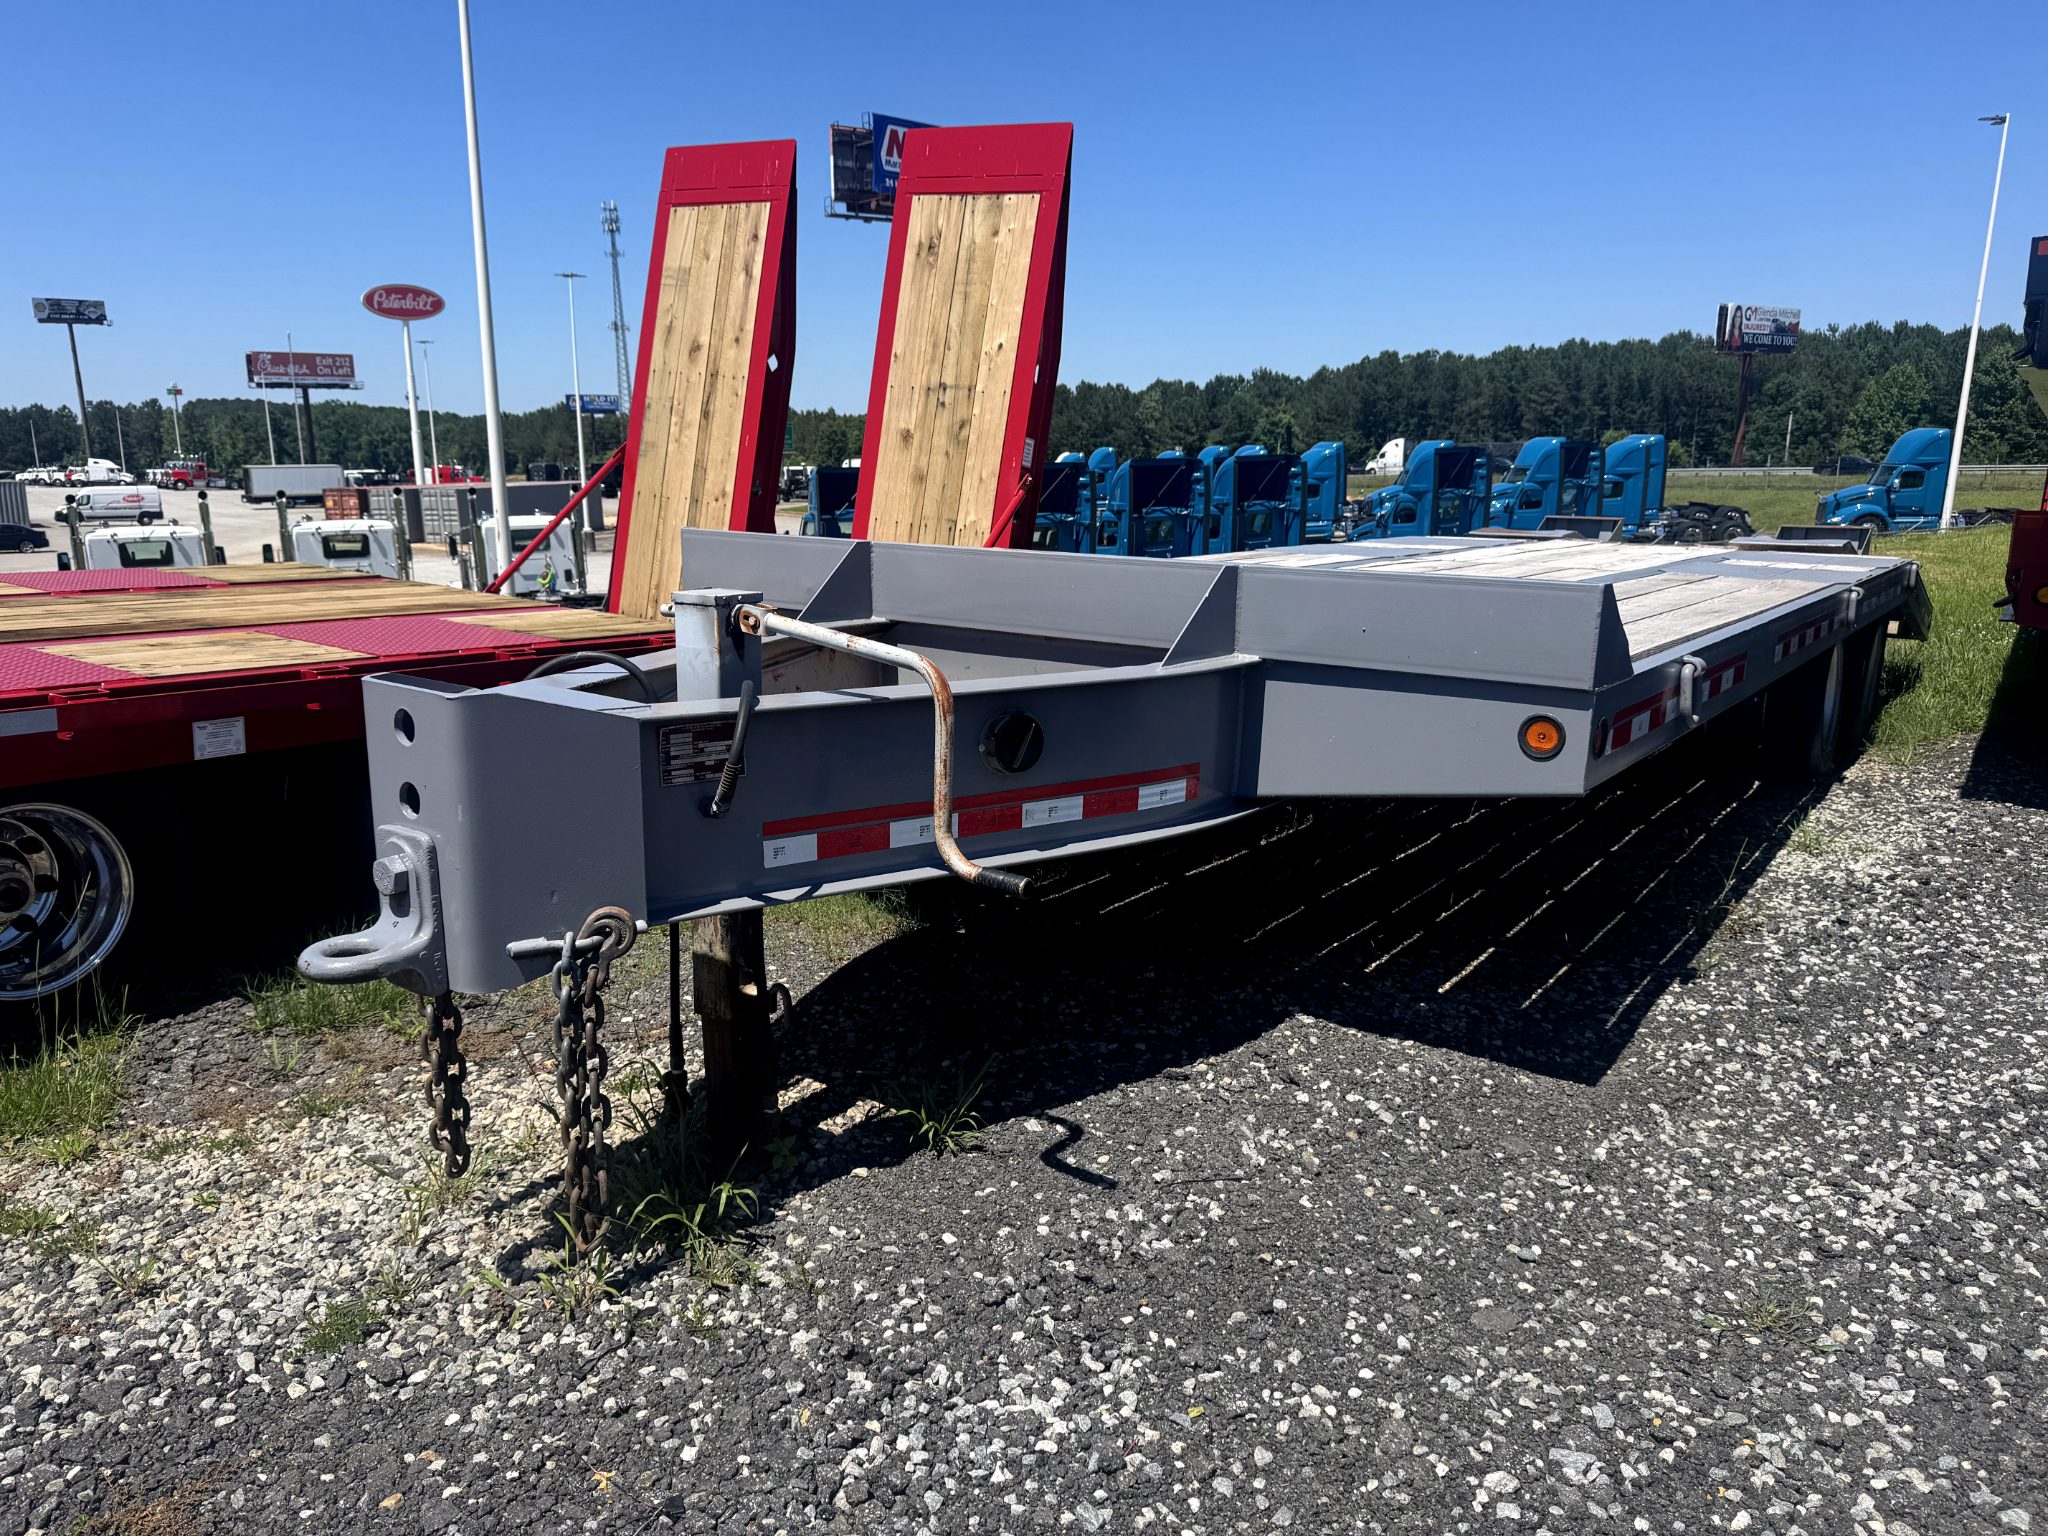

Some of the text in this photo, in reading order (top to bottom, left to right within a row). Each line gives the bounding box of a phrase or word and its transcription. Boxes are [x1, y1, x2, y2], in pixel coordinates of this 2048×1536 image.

[373, 290, 438, 310] Peterbilt
[1744, 334, 1753, 343] WE
[1754, 335, 1772, 344] COME
[1774, 336, 1782, 345] TO
[316, 357, 350, 365] Exit 212
[334, 367, 352, 375] Left
